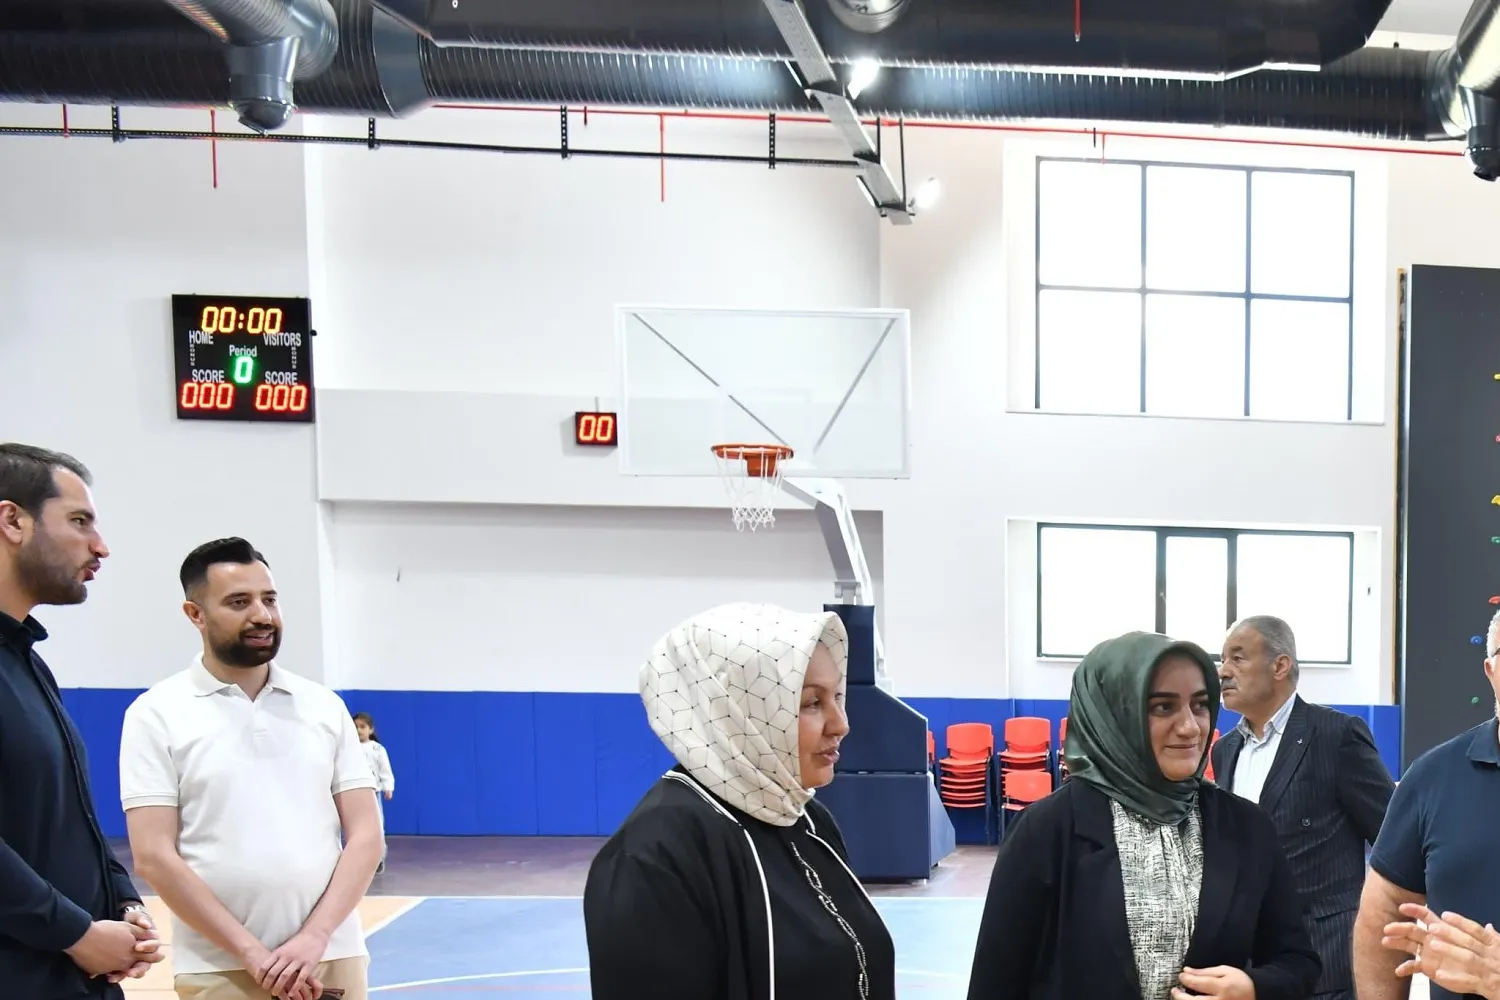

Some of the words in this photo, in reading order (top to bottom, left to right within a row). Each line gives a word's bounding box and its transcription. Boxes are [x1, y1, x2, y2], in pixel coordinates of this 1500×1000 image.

[201, 306, 282, 334] 00:00
[189, 330, 214, 345] HOME
[263, 332, 302, 347] VISITORS
[229, 344, 257, 358] Period
[191, 369, 225, 384] SCORE
[233, 356, 254, 384] 0
[264, 371, 298, 386] SCORE
[181, 382, 234, 409] 000
[255, 384, 308, 411] 000
[579, 415, 613, 441] 00
